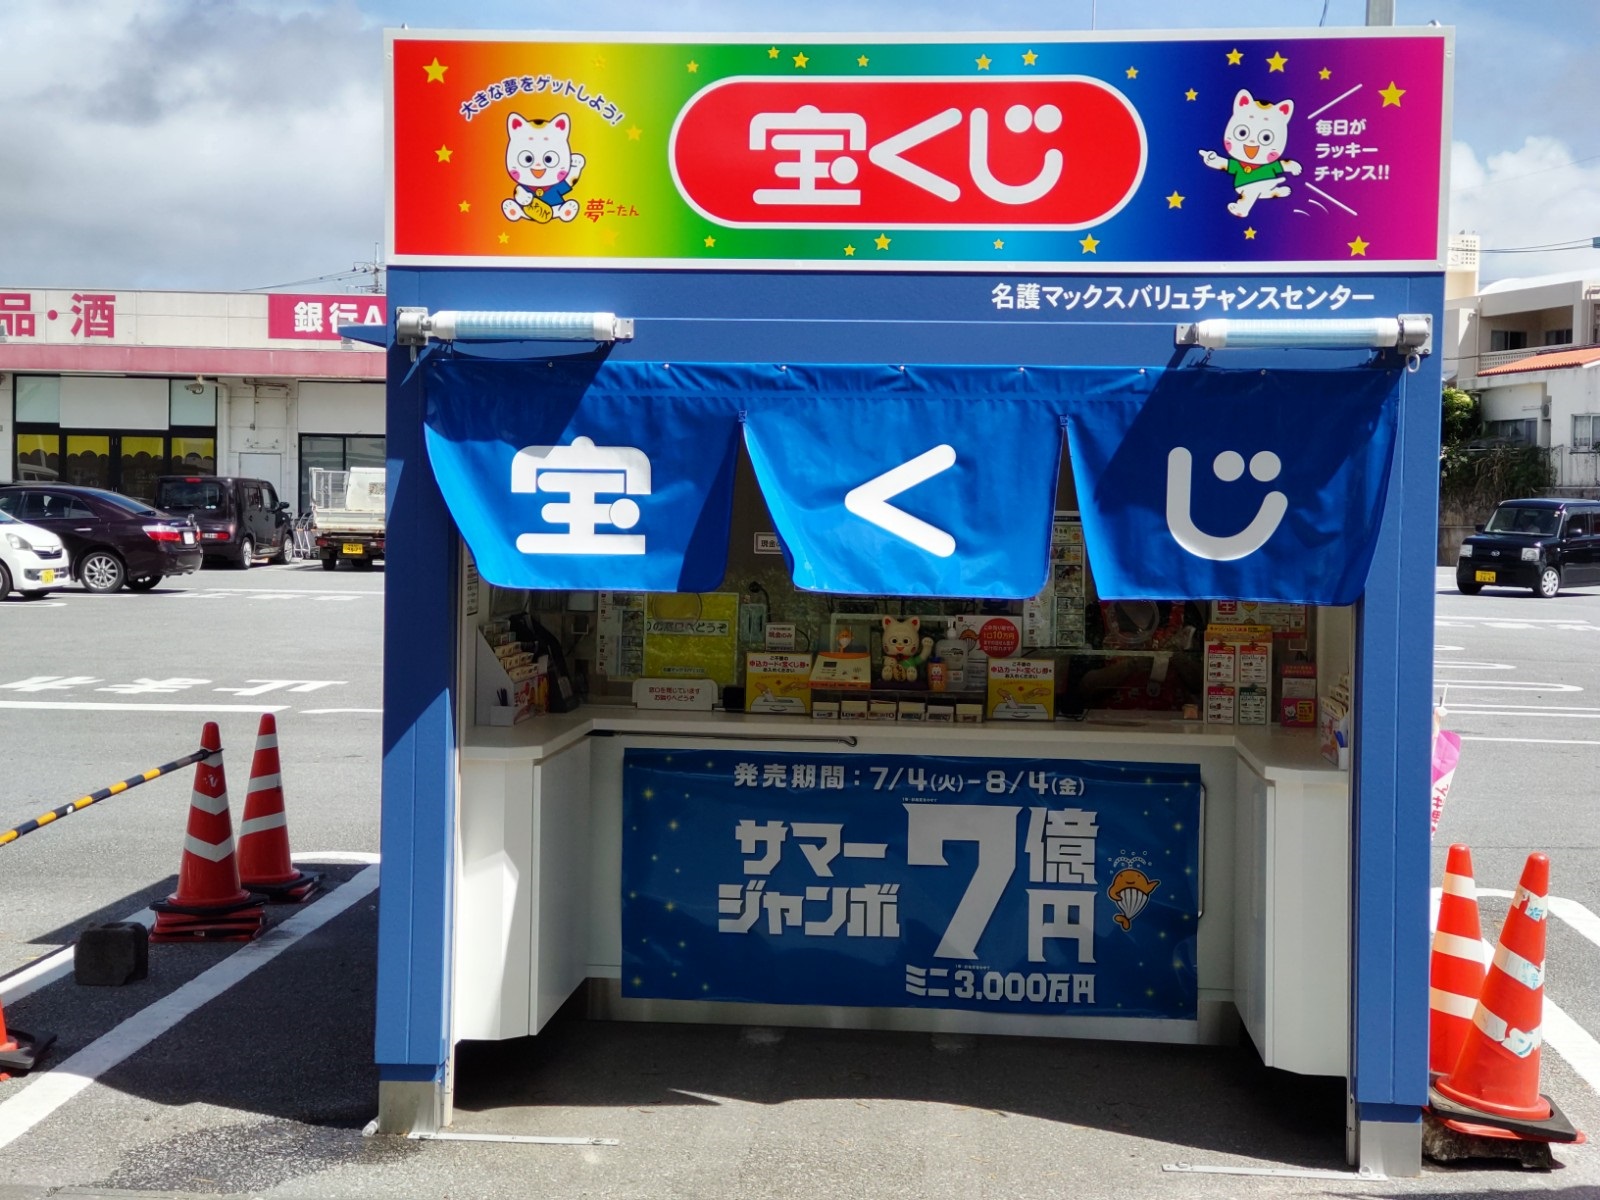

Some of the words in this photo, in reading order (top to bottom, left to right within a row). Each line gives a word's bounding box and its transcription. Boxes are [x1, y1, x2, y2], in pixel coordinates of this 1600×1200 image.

[459, 75, 625, 126] 大きな夢をゲットしよう!
[1315, 118, 1367, 138] 毎日が
[1315, 142, 1379, 159] ラッキー
[749, 103, 1063, 206] 宝くじ
[1314, 164, 1390, 182] チャンス!!
[991, 282, 1376, 312] 名護マックスバリュチャンスセンター
[734, 818, 888, 878] サマー
[902, 803, 1022, 960] 7
[718, 881, 900, 938] ジャンボ
